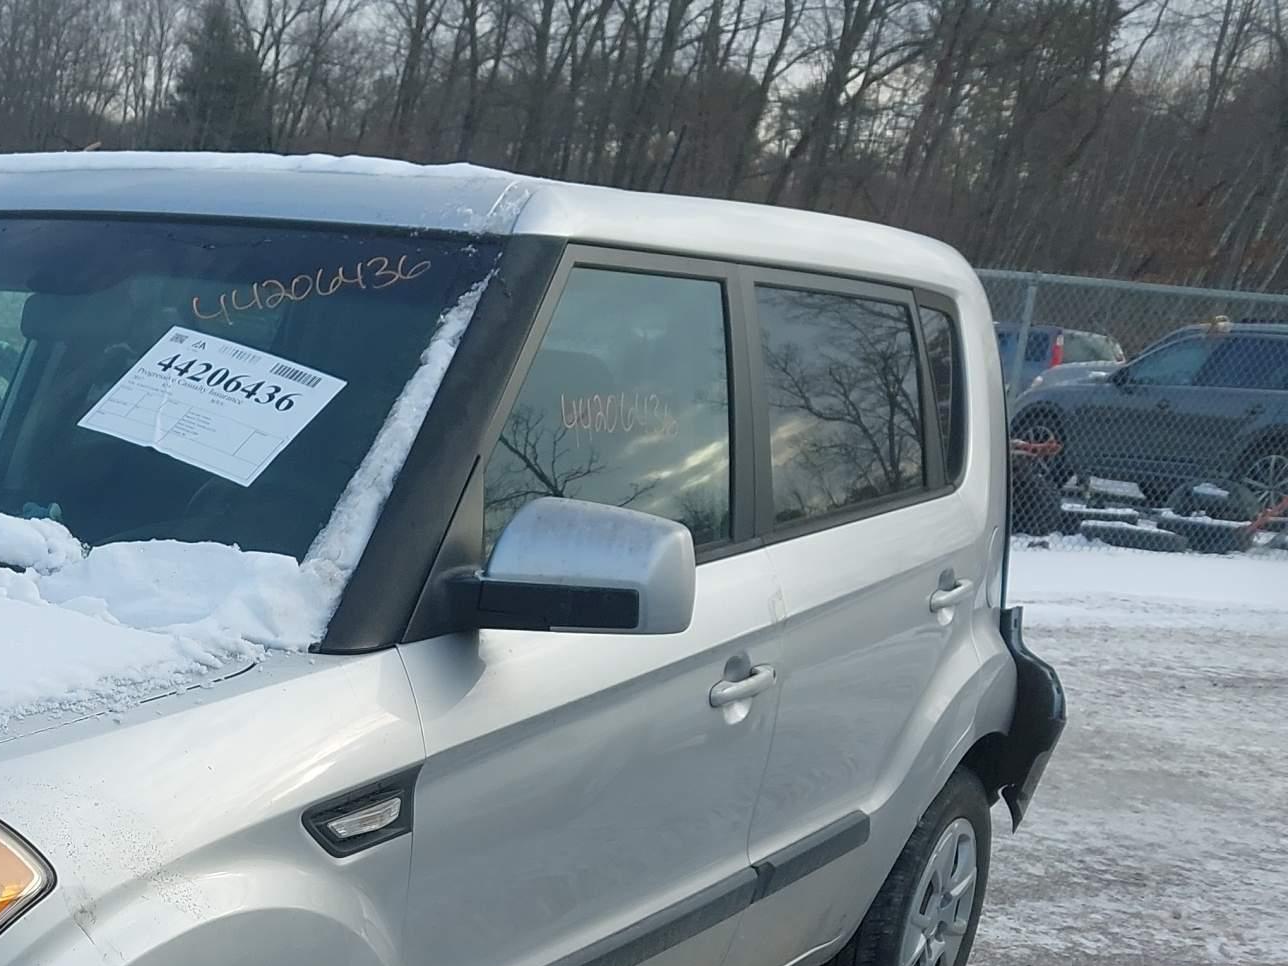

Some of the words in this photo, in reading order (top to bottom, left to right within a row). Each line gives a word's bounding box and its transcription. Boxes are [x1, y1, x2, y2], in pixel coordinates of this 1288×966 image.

[192, 254, 432, 326] 44206436
[156, 352, 304, 413] 44206436
[560, 391, 679, 449] 44206436
